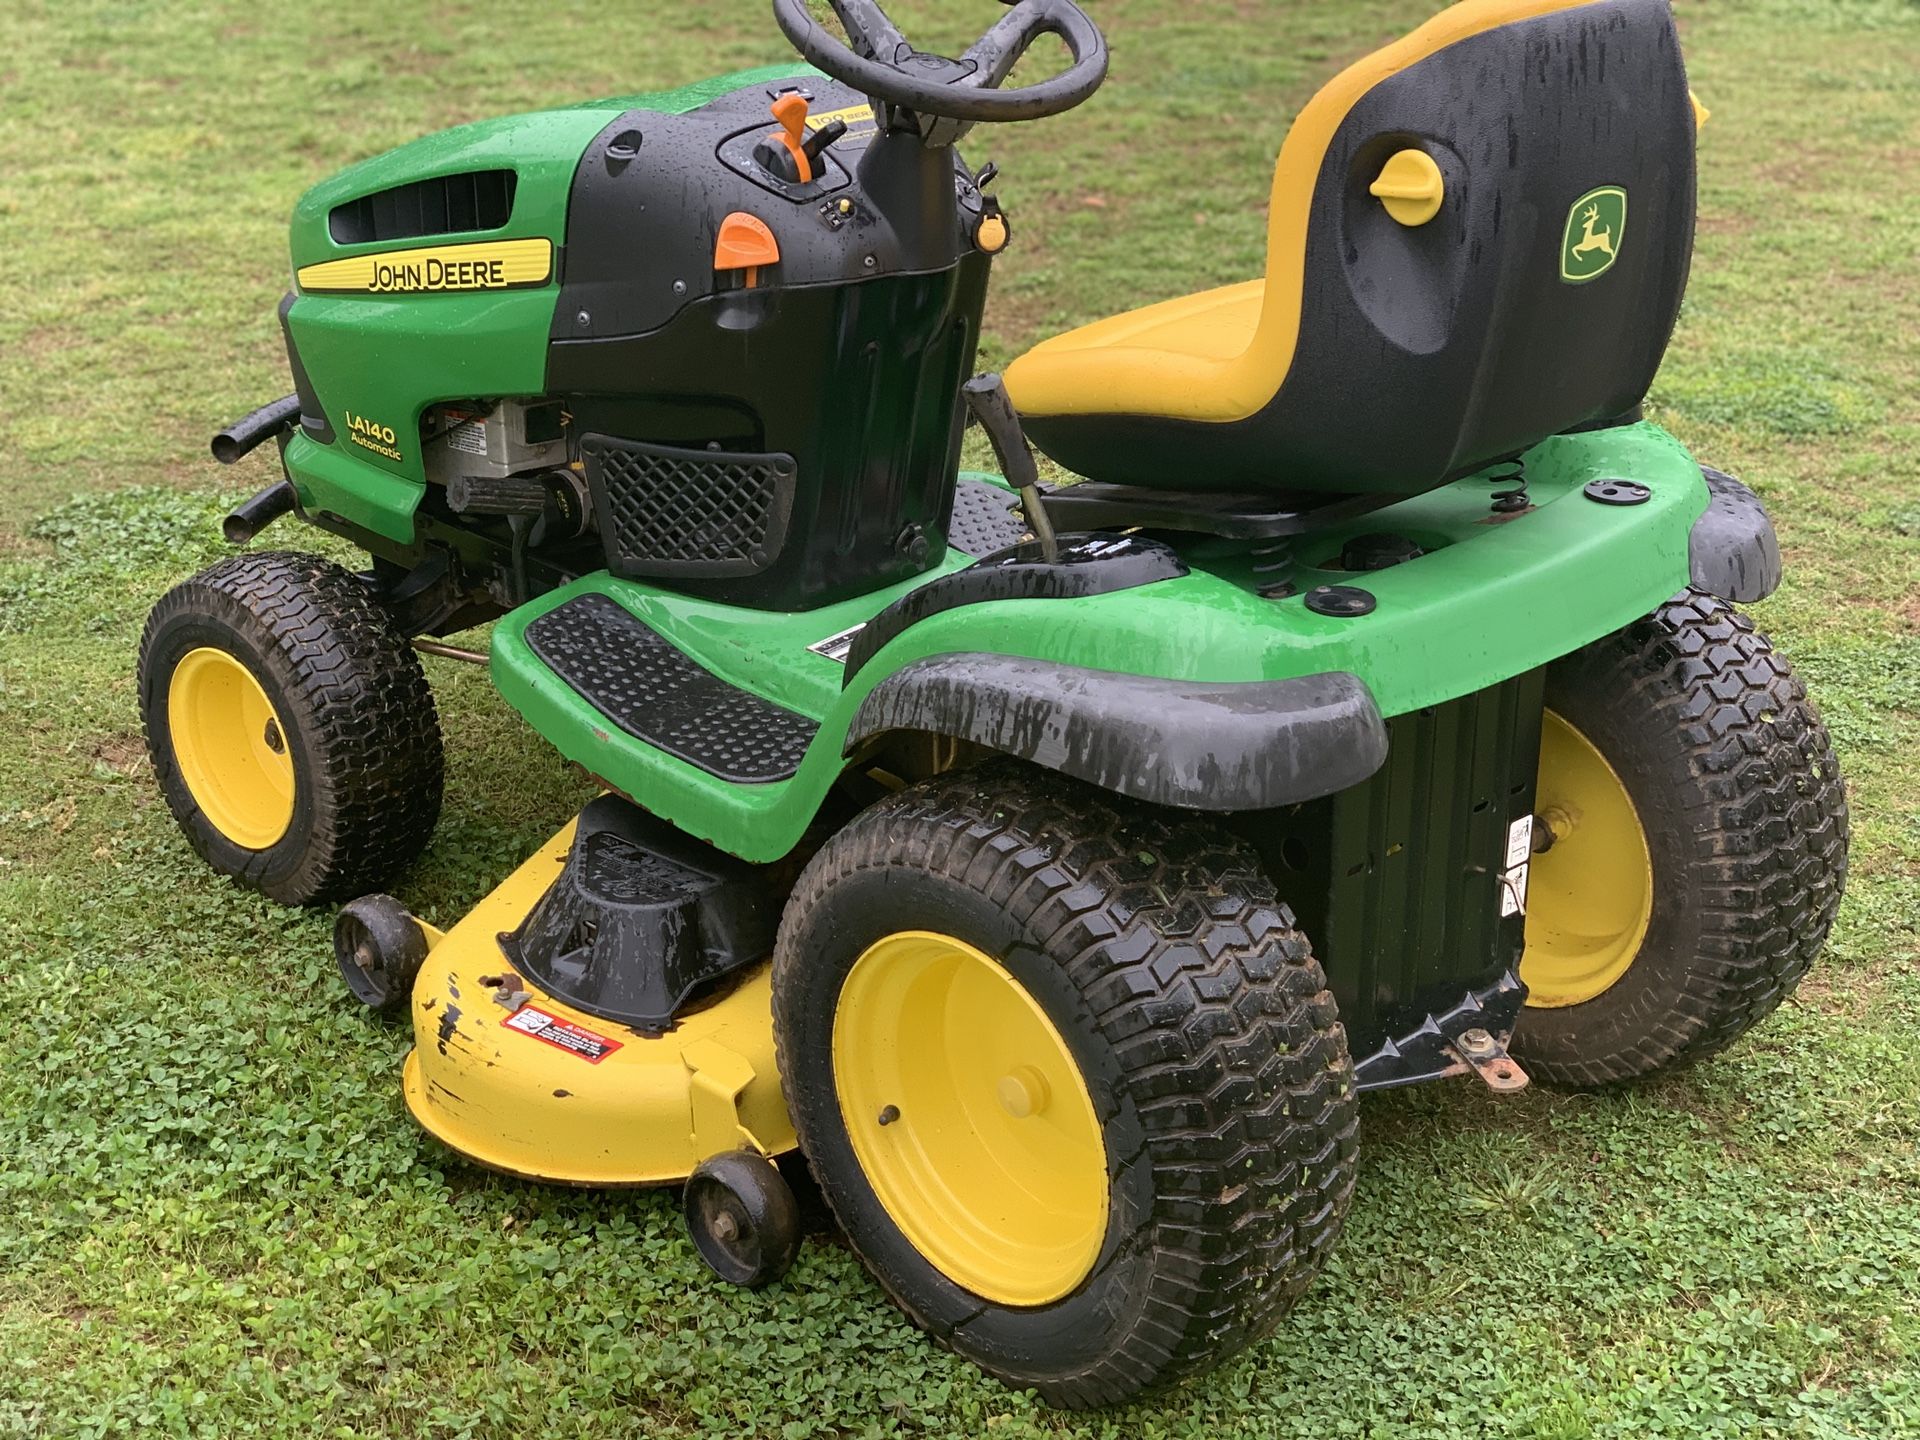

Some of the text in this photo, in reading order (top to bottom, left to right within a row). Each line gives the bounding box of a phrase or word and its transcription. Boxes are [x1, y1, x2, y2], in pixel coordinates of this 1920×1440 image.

[368, 258, 504, 289] JOHN DEERE
[345, 410, 395, 444] LA140
[351, 432, 402, 461] Automatic
[553, 1026, 601, 1047] ROTATING BLADE
[574, 1026, 605, 1042] DANGER
